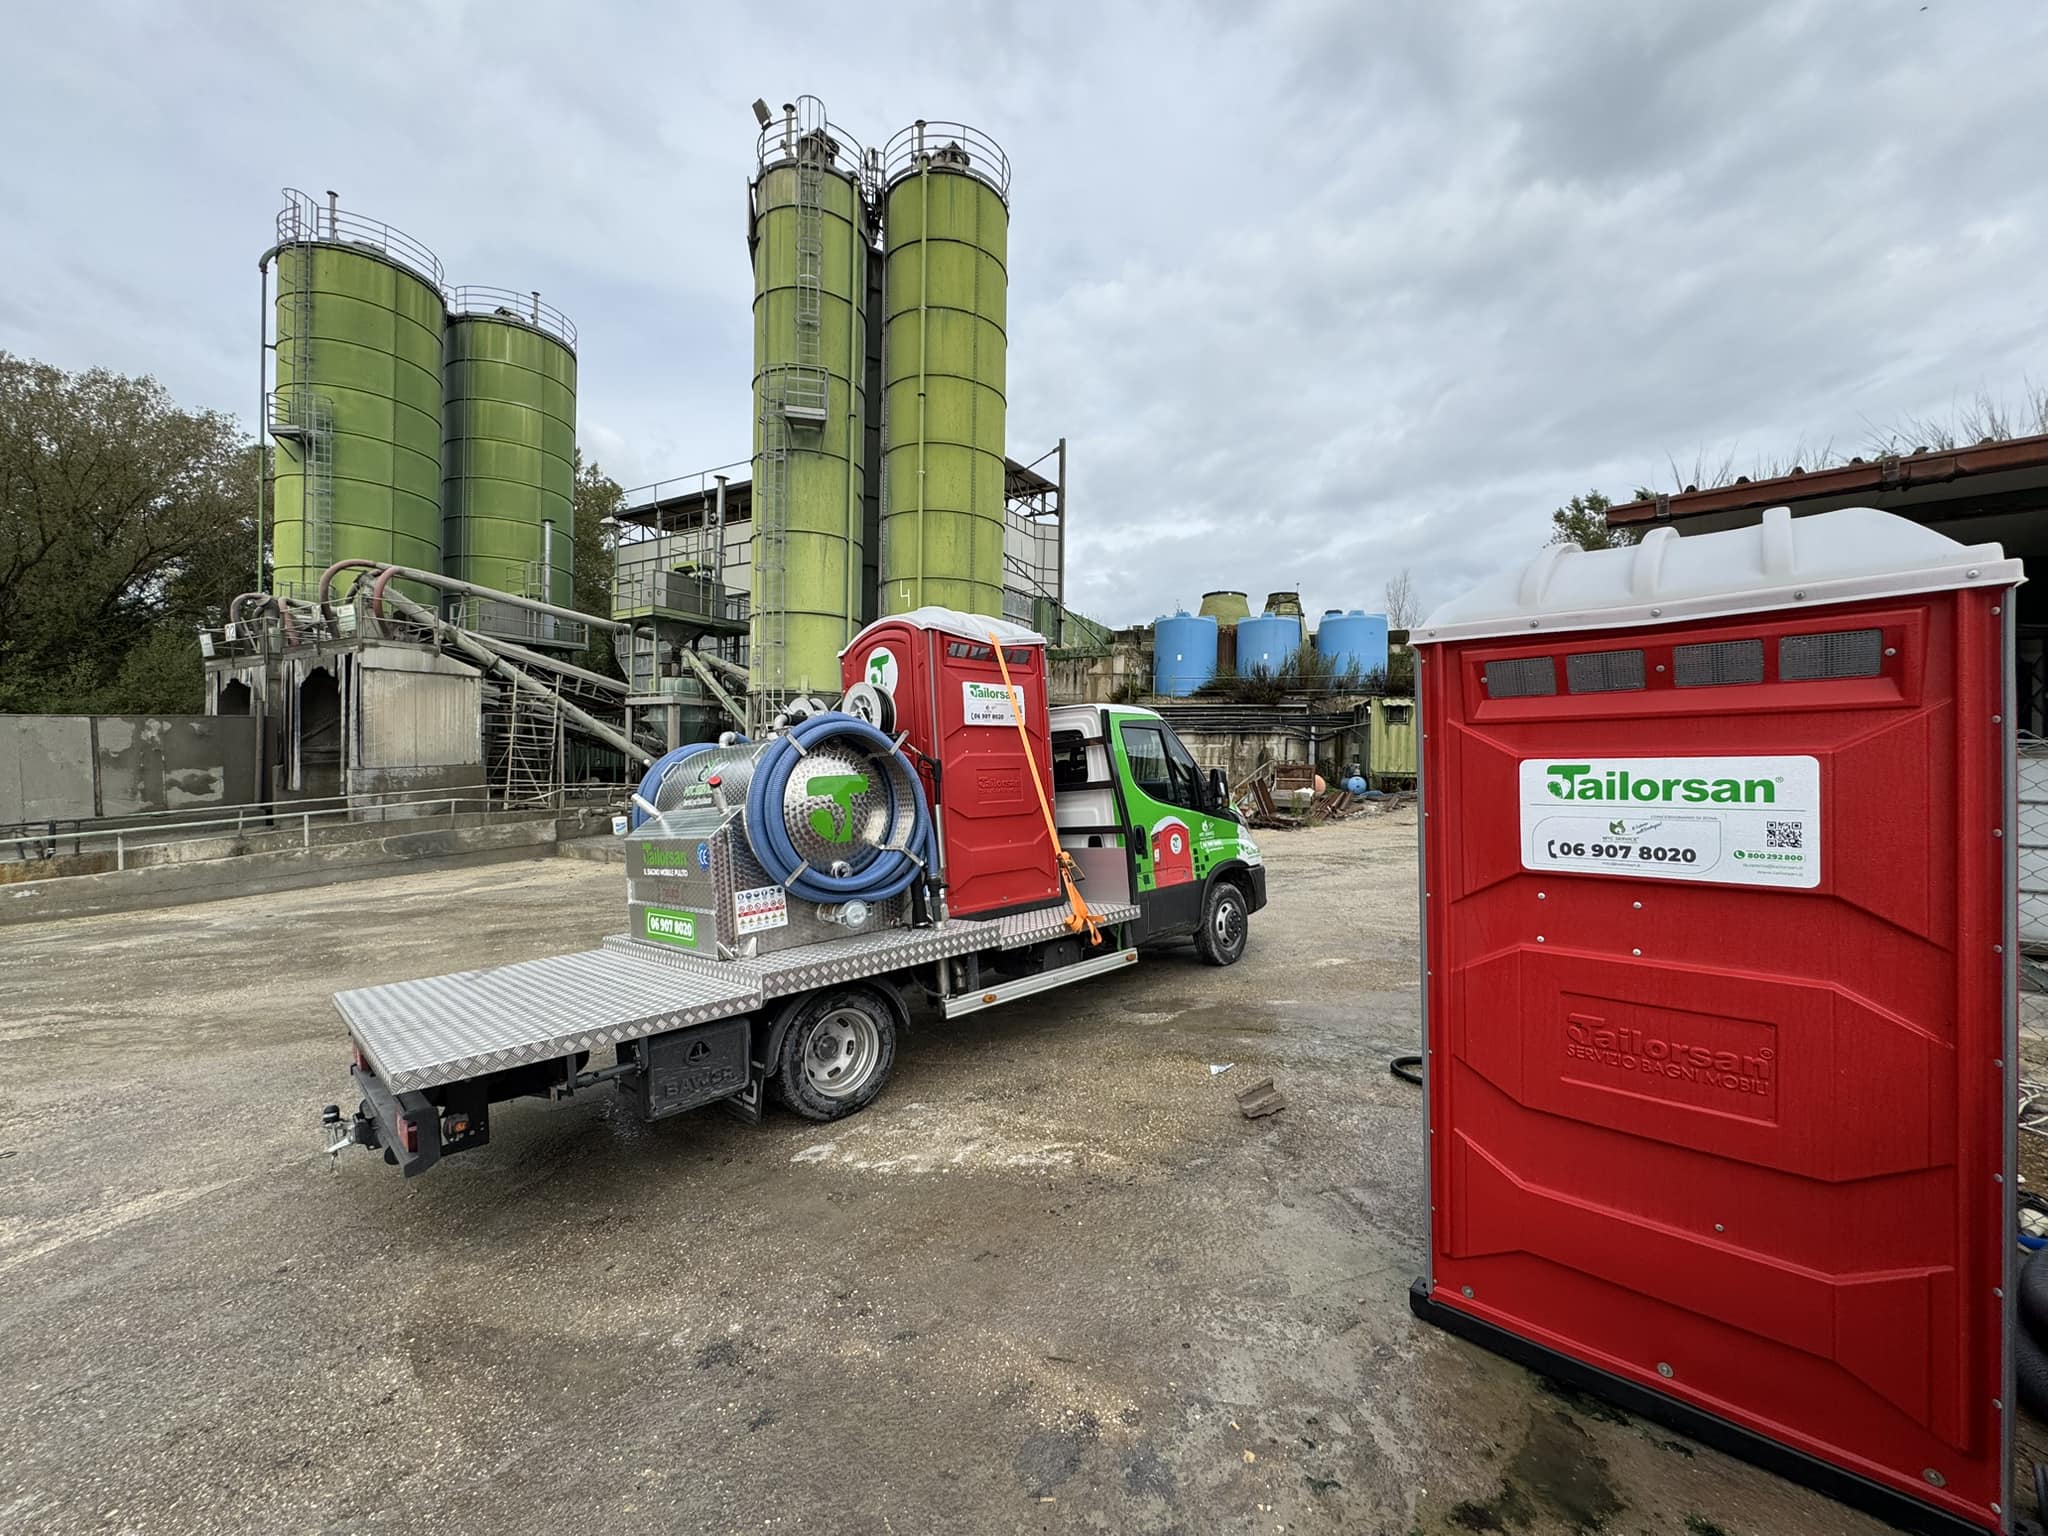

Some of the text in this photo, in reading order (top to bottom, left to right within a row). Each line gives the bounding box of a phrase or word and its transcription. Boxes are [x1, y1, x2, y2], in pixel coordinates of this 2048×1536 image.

[1560, 842, 1696, 863] 06 907 8020
[650, 916, 659, 930] 06
[660, 918, 672, 933] 907
[1567, 1043, 1769, 1097] SERVIZIO BAGNI MOBILI
